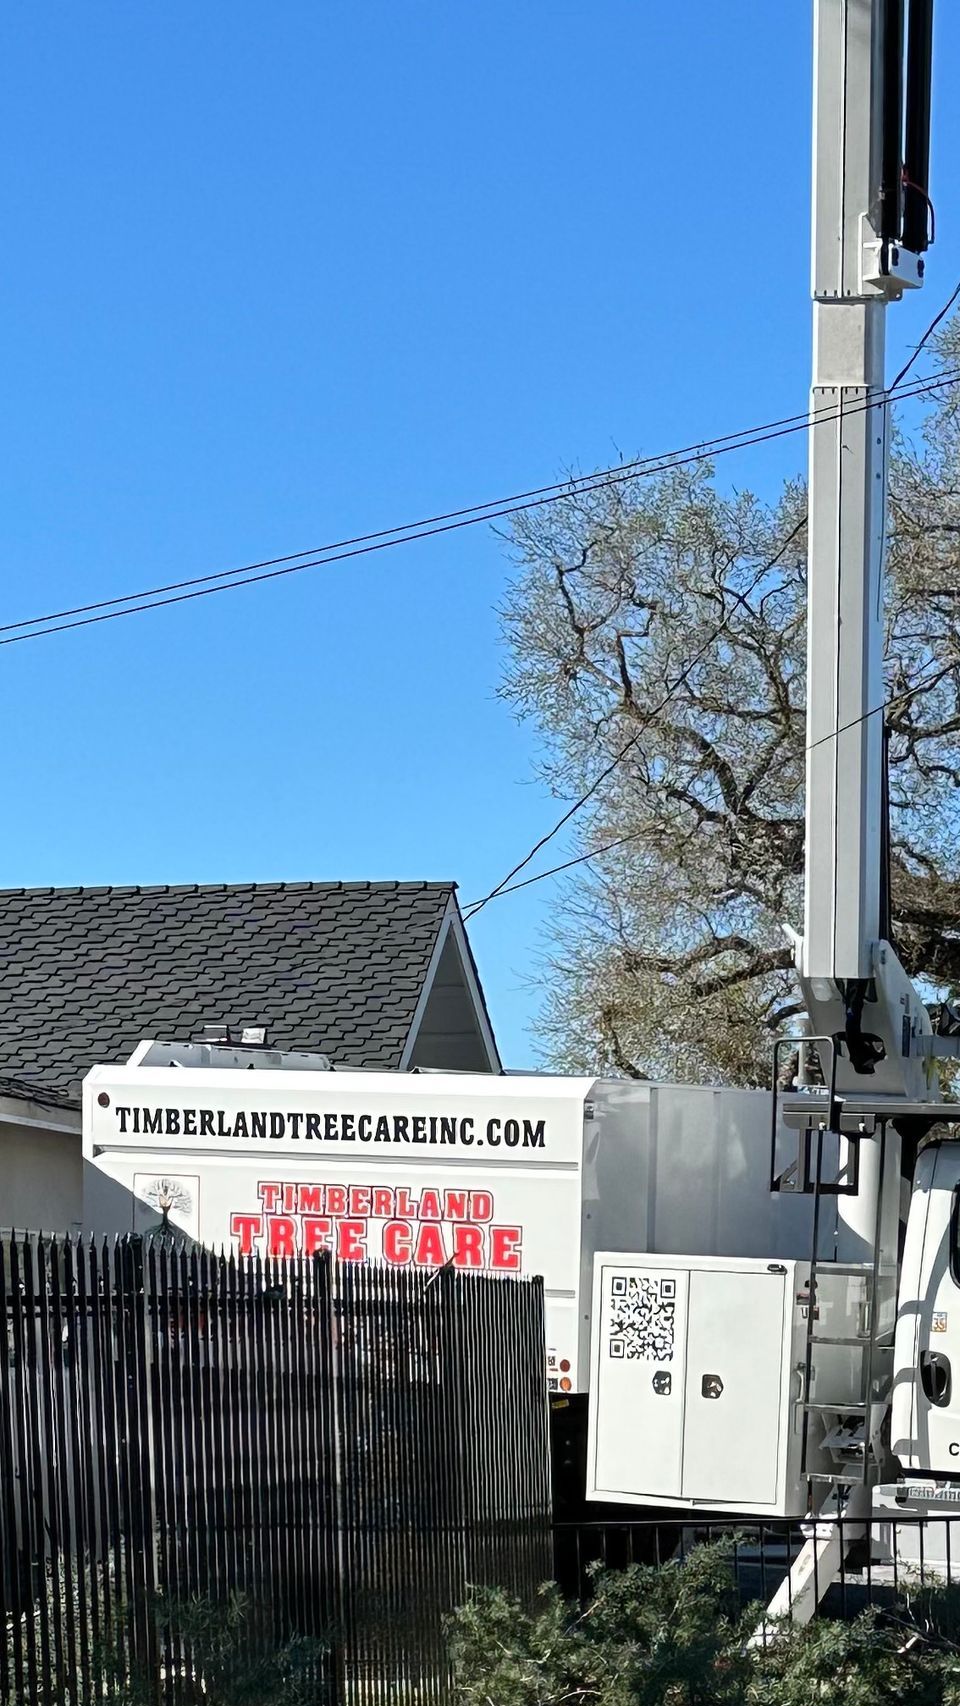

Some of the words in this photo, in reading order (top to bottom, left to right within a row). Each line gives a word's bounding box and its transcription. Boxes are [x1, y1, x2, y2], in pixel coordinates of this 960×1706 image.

[116, 1107, 546, 1148] TIMBERLANDTREECAREINC.COM
[258, 1181, 494, 1223] TIMBERLAND
[230, 1212, 368, 1263] TREE
[382, 1219, 523, 1271] CARE
